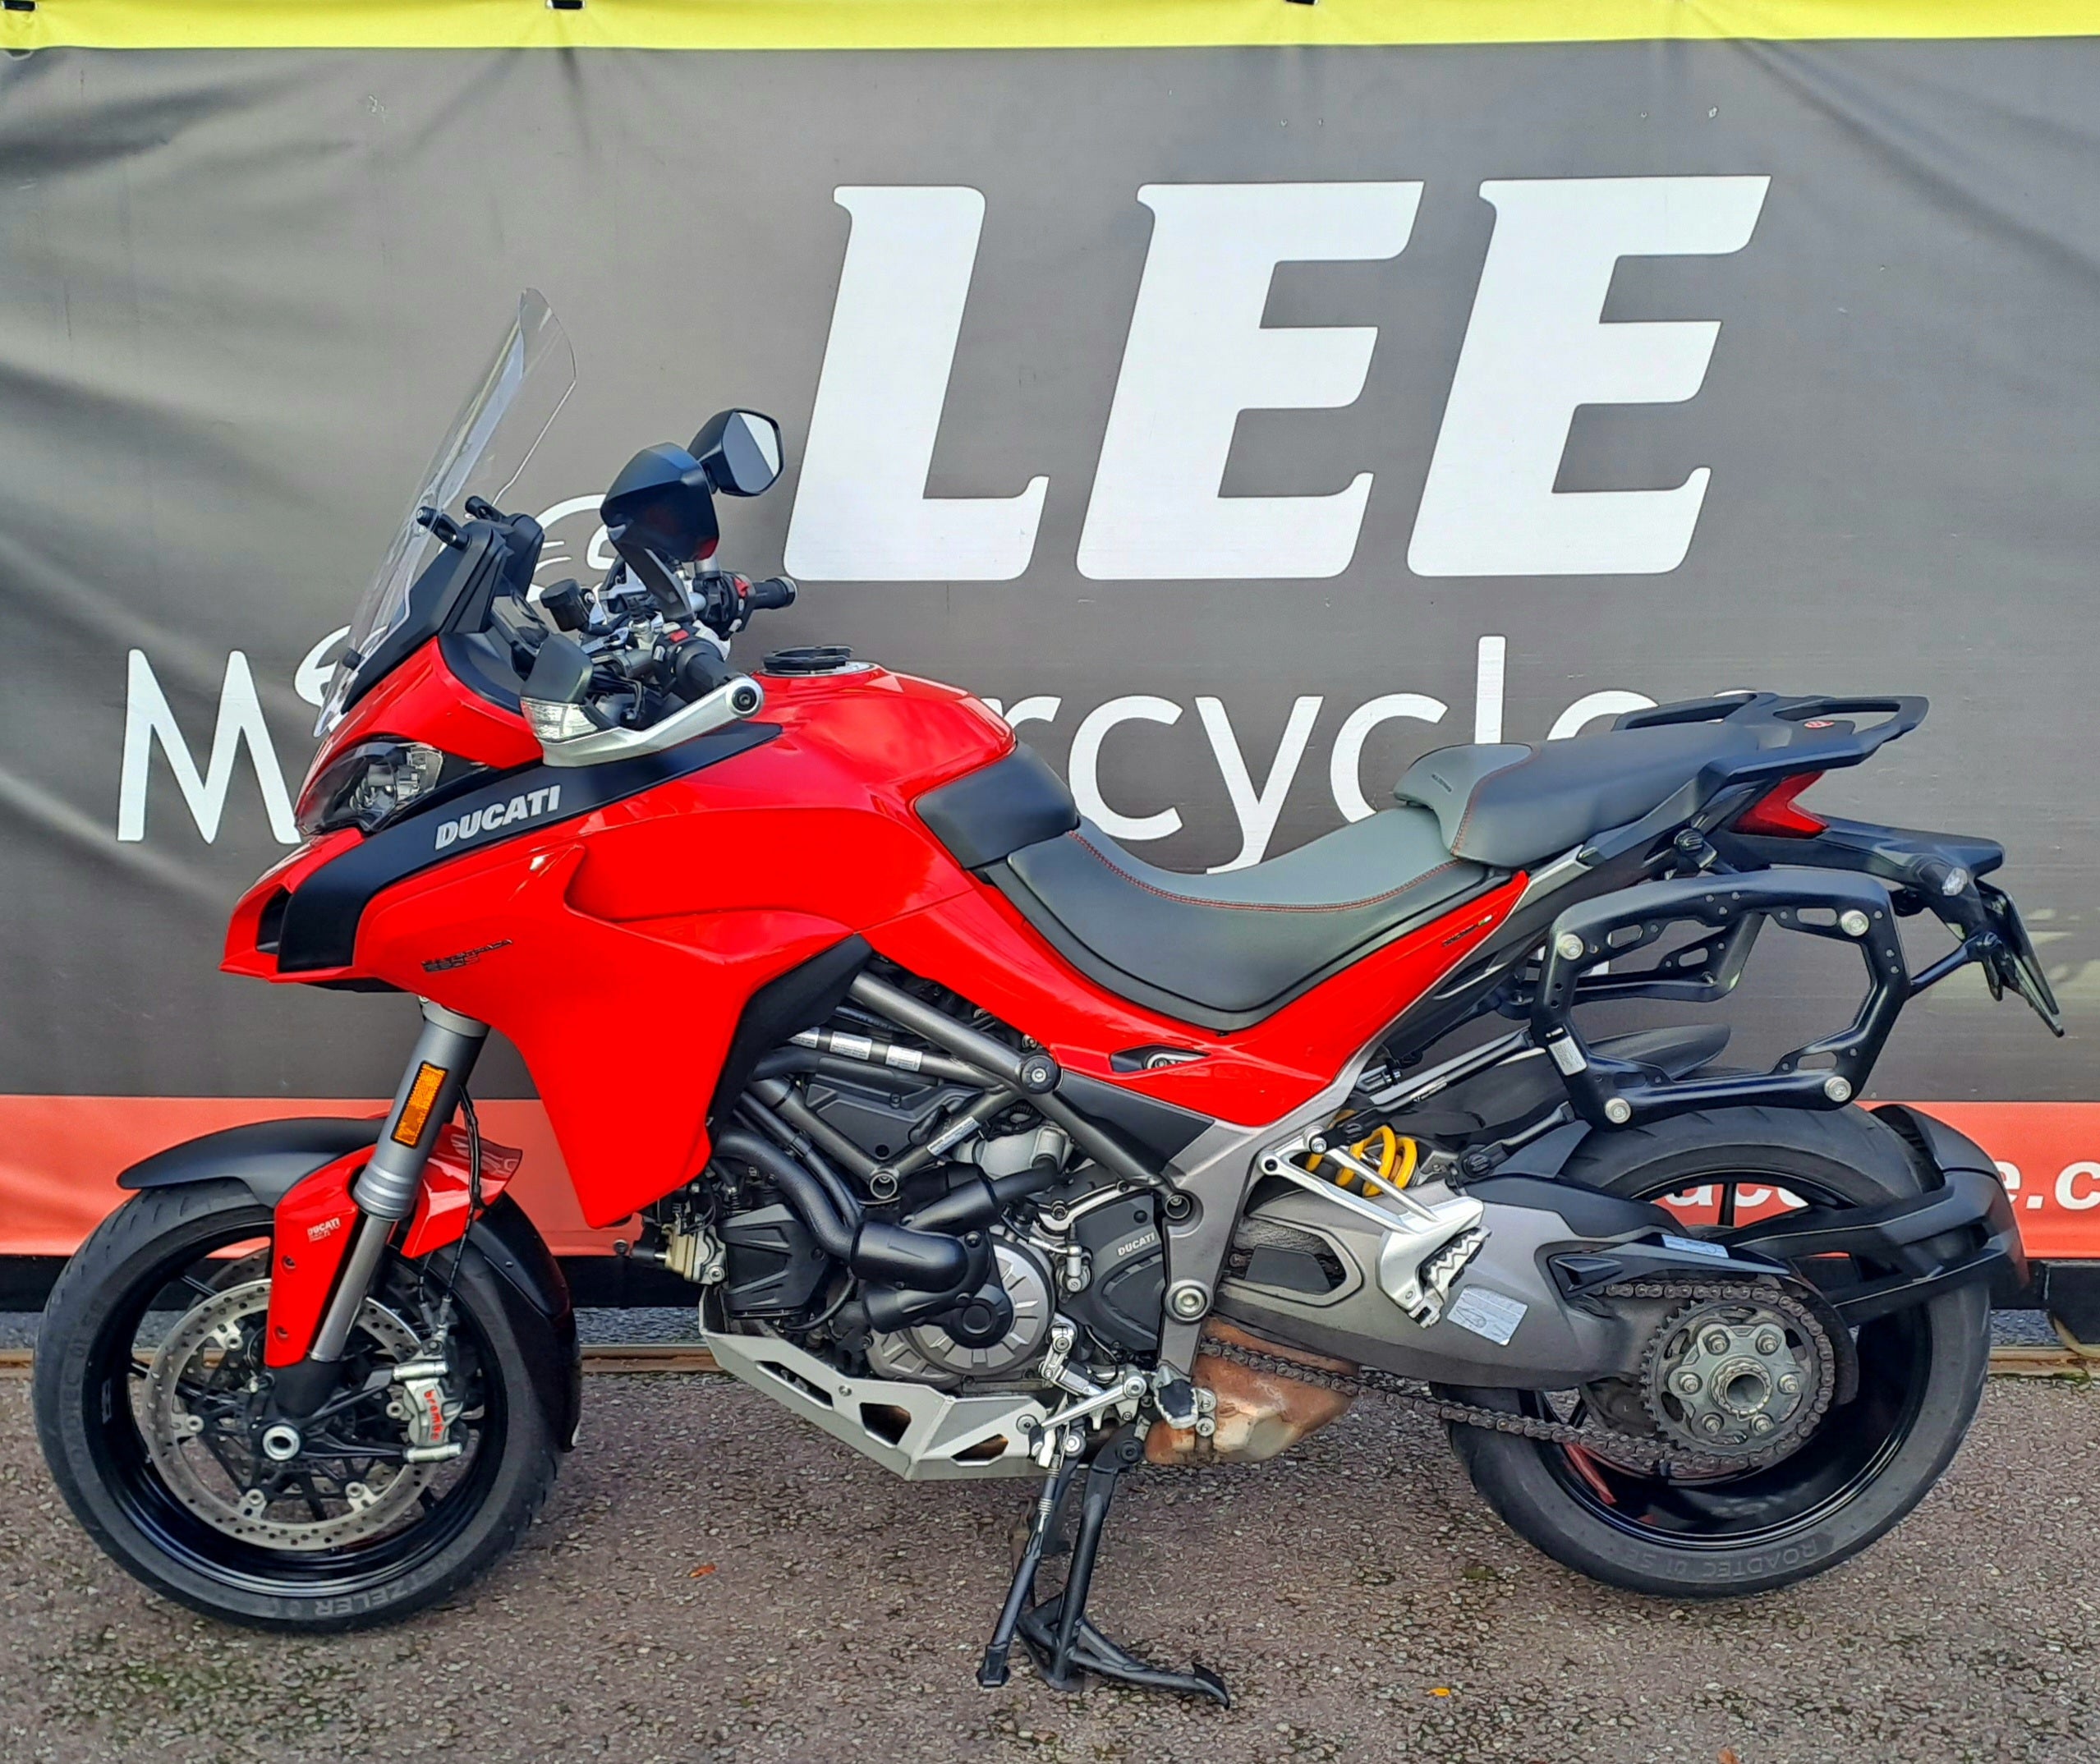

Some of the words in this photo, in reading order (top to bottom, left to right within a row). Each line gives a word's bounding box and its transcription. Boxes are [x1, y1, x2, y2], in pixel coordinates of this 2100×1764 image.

[783, 175, 1771, 581] LEE
[434, 784, 561, 851] DUCATI
[307, 1216, 341, 1237] DUCATI
[1118, 1232, 1156, 1256] DUCATI
[1701, 1538, 1819, 1578] ROADTEC
